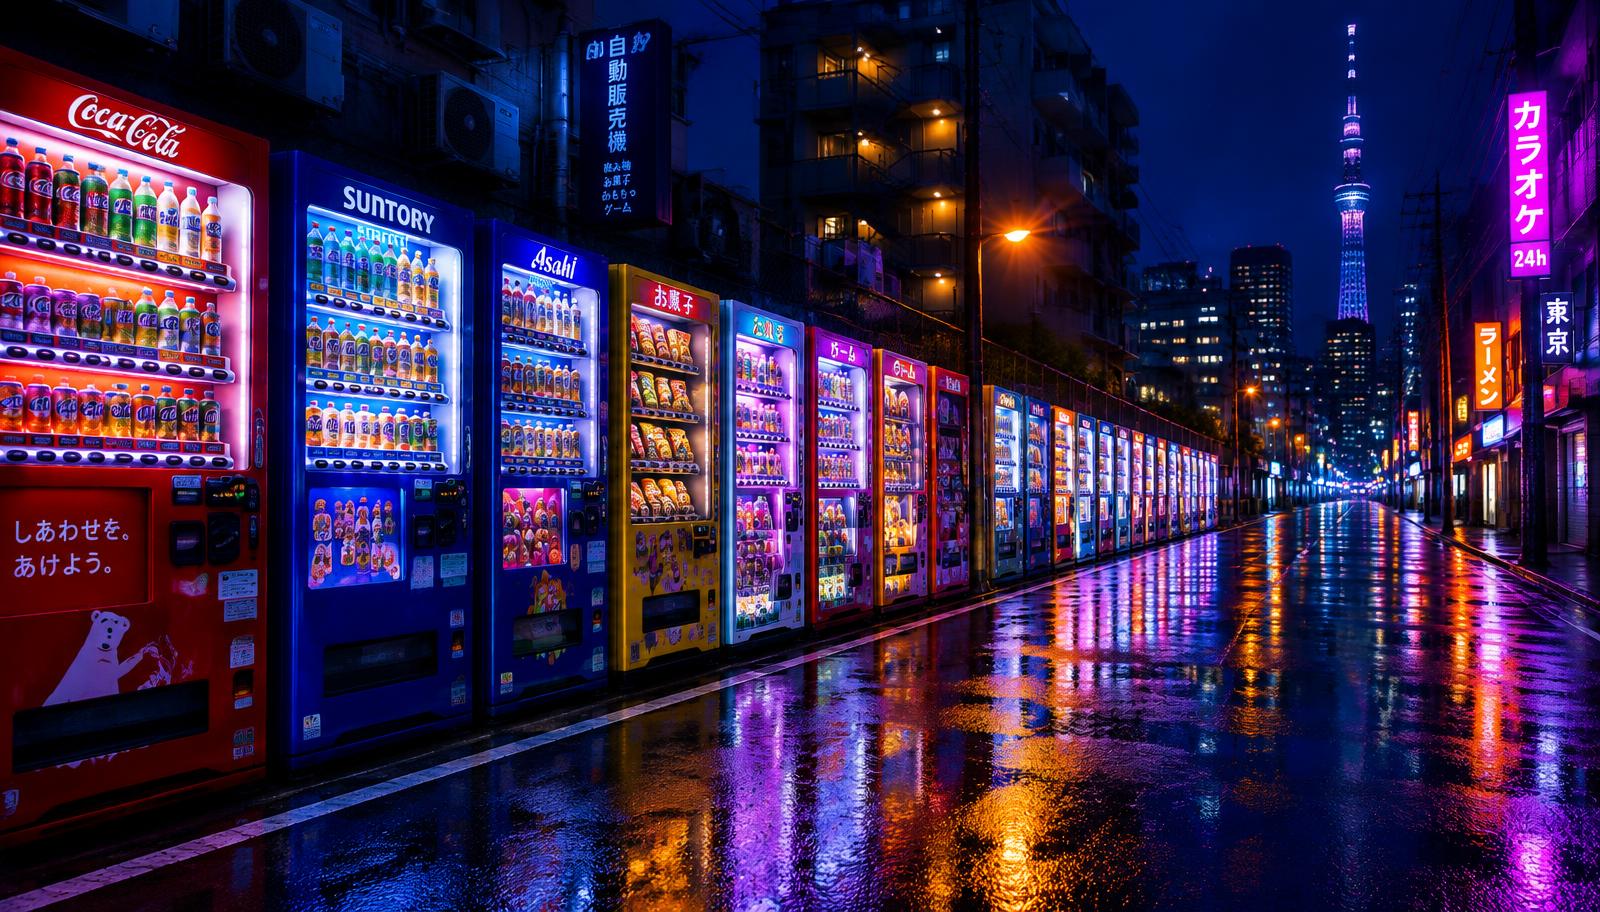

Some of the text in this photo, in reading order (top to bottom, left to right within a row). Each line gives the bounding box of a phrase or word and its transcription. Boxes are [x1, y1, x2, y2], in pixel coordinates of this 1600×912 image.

[68, 94, 186, 158] Coca-Cola
[1513, 101, 1544, 235] カラオケ
[343, 185, 435, 234] SUNTORY
[531, 246, 578, 280] Asahi
[1514, 249, 1546, 268] 24h
[1546, 298, 1569, 356] 東京
[1480, 327, 1498, 406] ラーメン
[15, 518, 130, 544] しあわせを。
[14, 552, 112, 578] あけよう。
